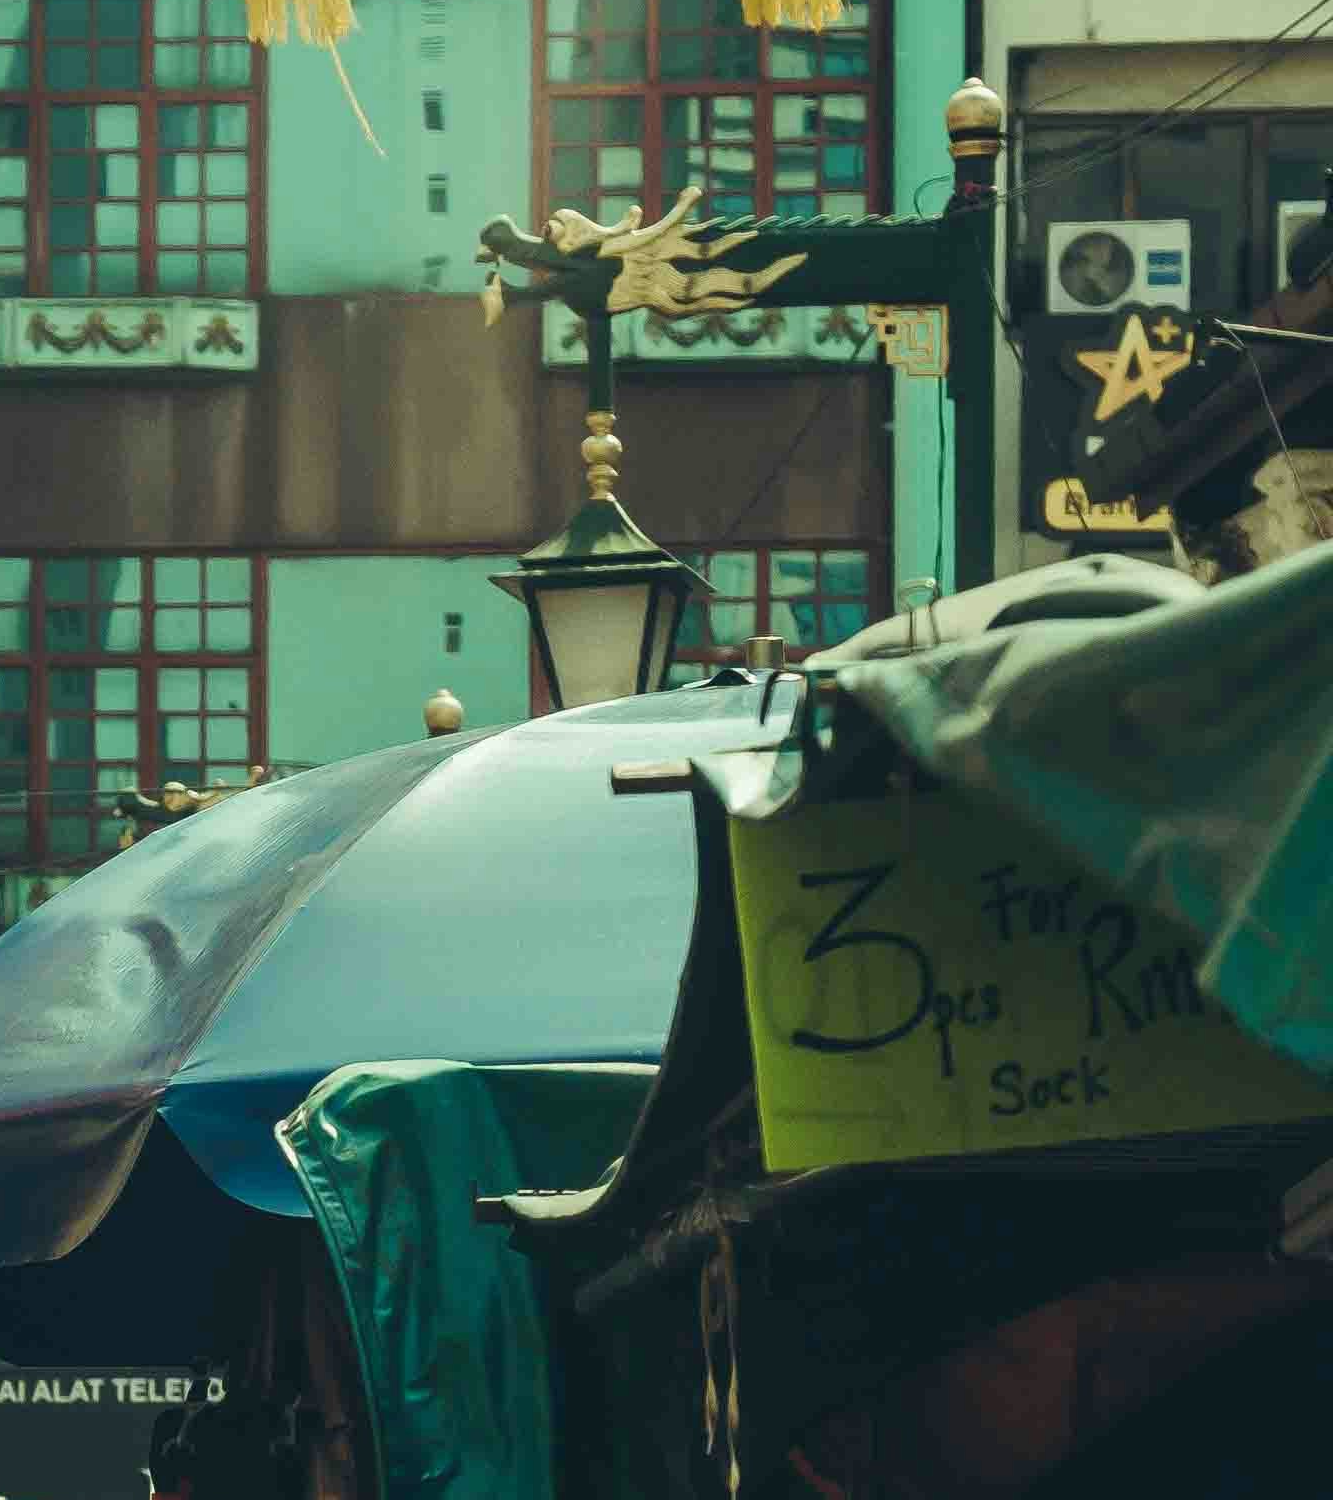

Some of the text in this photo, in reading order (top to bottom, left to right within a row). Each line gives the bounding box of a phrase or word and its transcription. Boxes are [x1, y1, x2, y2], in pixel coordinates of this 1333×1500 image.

[790, 862, 933, 1053] 3
[988, 1056, 1112, 1116] Sock
[32, 1378, 105, 1403] ALAT
